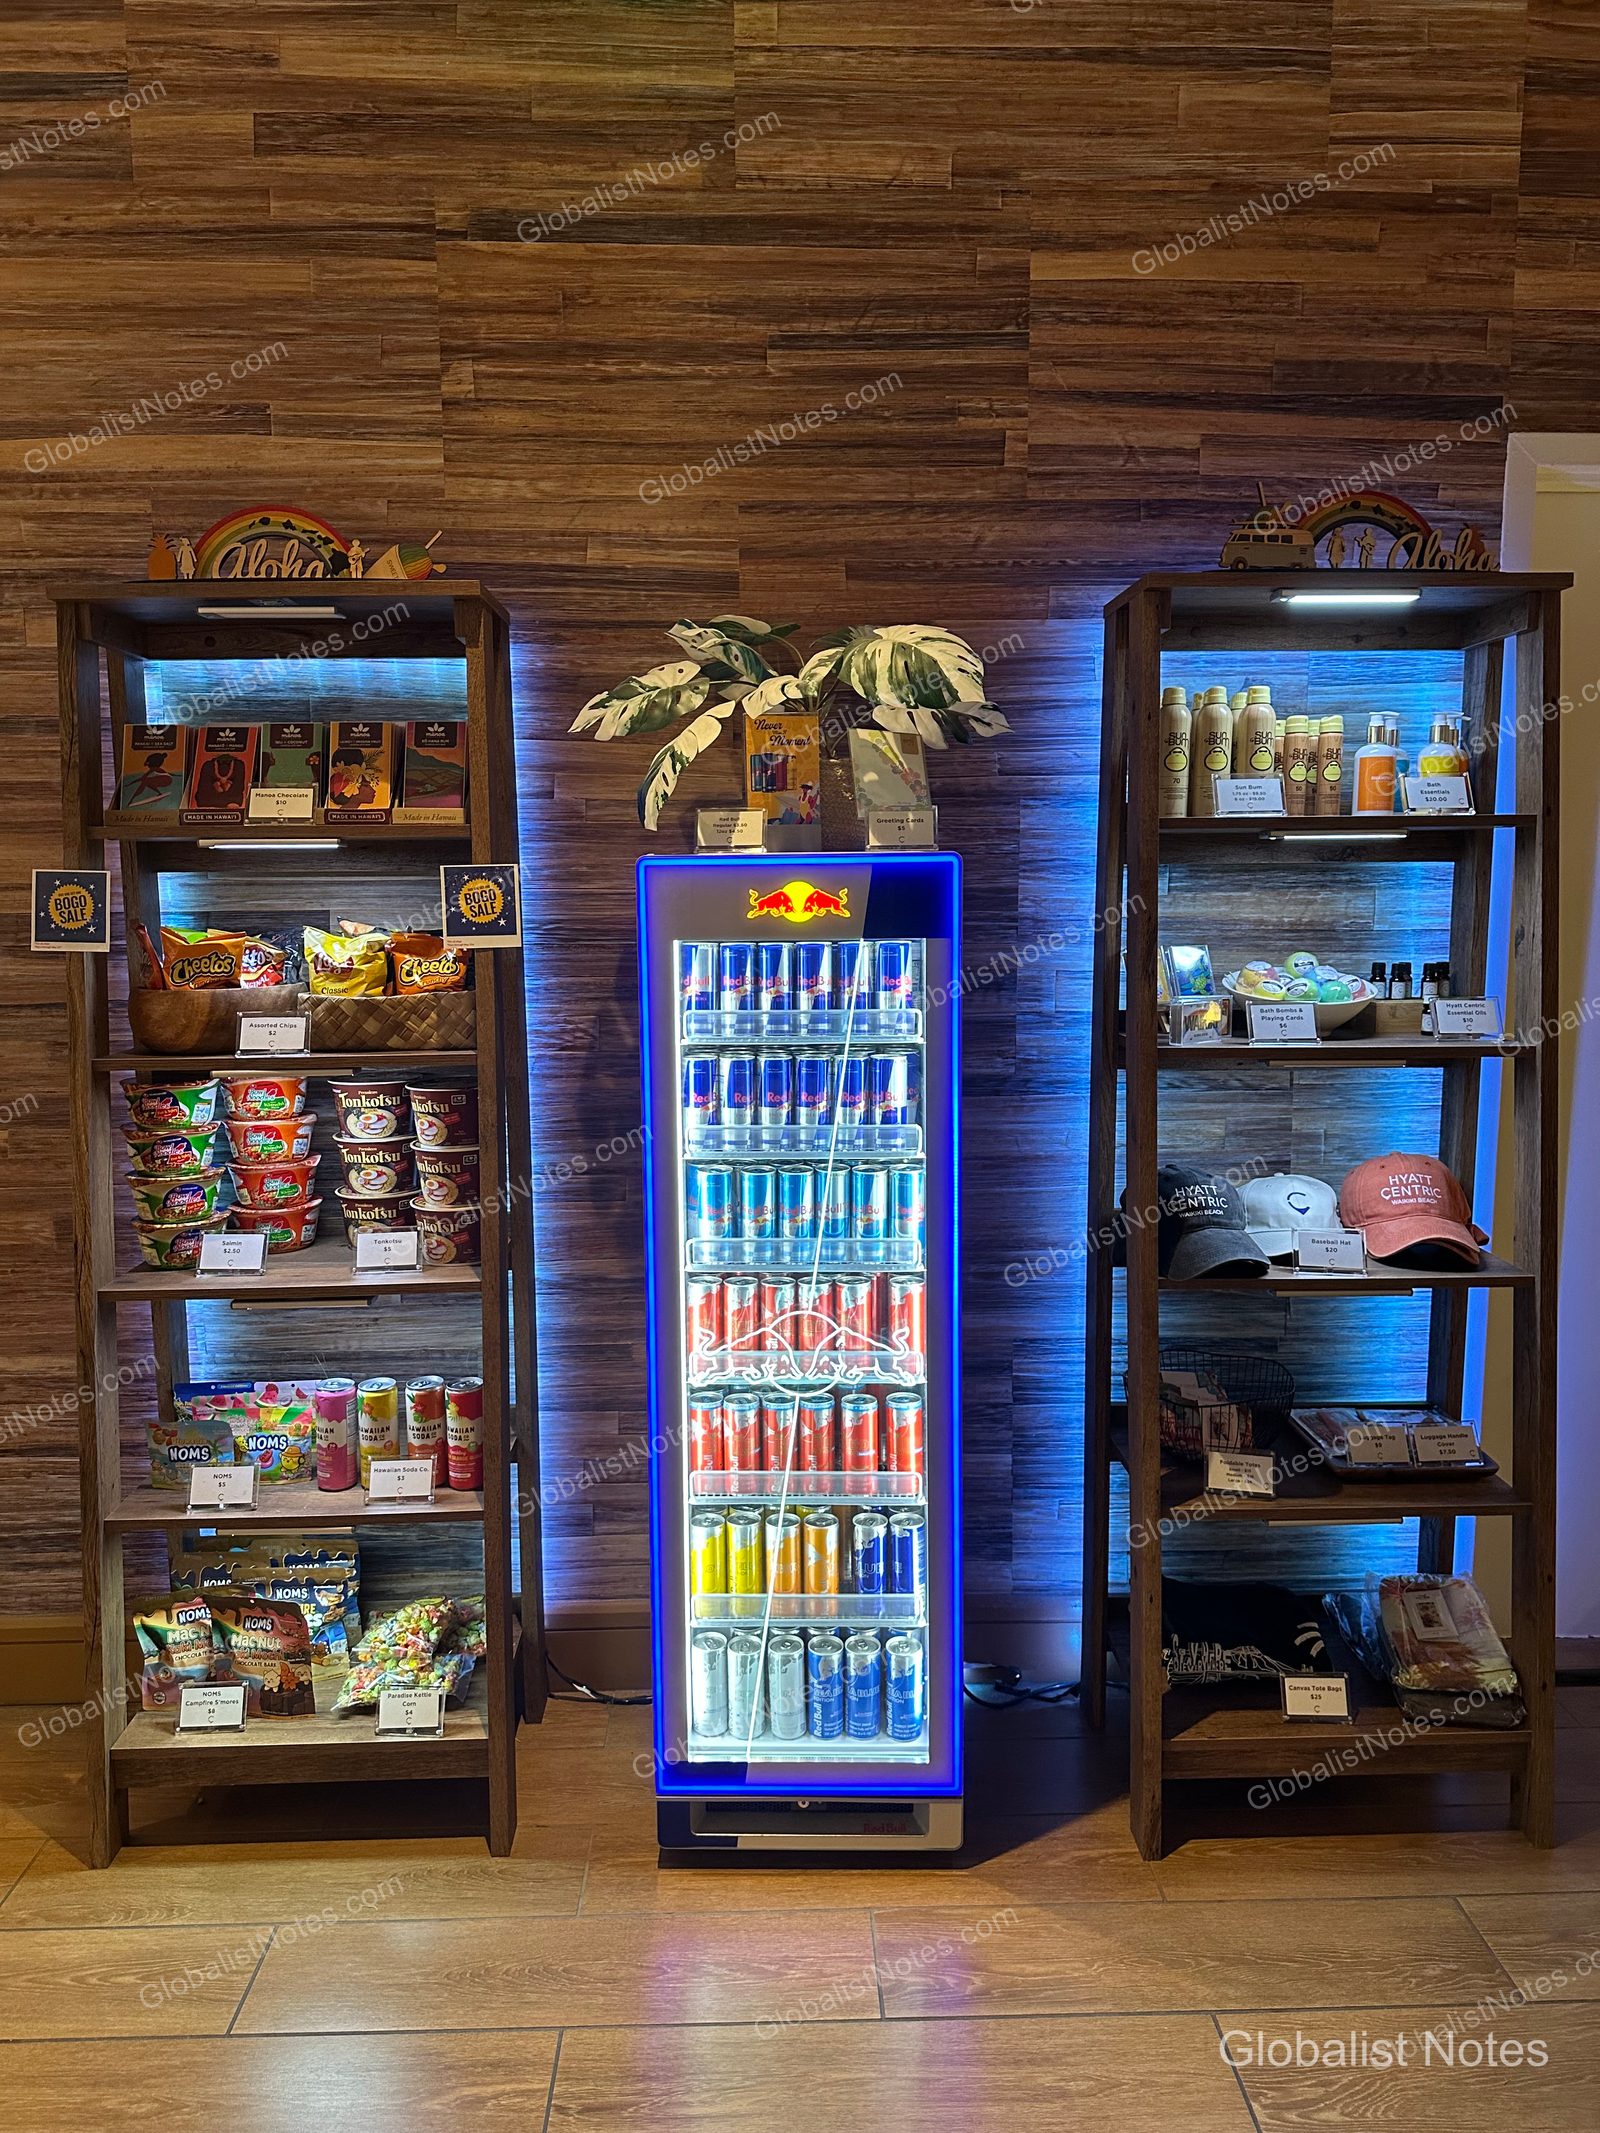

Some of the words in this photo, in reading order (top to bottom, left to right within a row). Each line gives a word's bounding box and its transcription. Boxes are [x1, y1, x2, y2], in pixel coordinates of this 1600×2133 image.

[1388, 528, 1501, 572] Aloha
[211, 538, 326, 579] Aloha
[753, 718, 784, 731] Never
[769, 734, 812, 747] Moment
[876, 817, 905, 825] Greeting
[54, 894, 88, 912] BOGO
[464, 888, 497, 906] BOGO
[59, 907, 88, 924] SALE
[469, 901, 498, 918] SALE
[170, 952, 235, 986] Cheetos
[722, 975, 743, 987] Red
[882, 975, 902, 987] Red
[321, 986, 350, 995] Classic
[1445, 1002, 1463, 1010] Hyatt
[1260, 1015, 1285, 1023] Playing
[248, 1022, 278, 1030] Assorted
[279, 1022, 298, 1030] Chips
[338, 1092, 401, 1109] Tonkotsu
[692, 1091, 712, 1103] Red
[734, 1091, 754, 1103] Red
[801, 1091, 822, 1103] Red
[842, 1091, 862, 1103] Red
[341, 1147, 401, 1165] Tonkotsu
[1388, 1172, 1433, 1186] HYATT
[1174, 1184, 1218, 1198] HYATT
[1380, 1184, 1442, 1200] CENTRIC
[1167, 1196, 1229, 1213] CENTRIC
[1391, 1197, 1417, 1206] WAIKIKI
[341, 1203, 397, 1220] Tonkotsu
[1204, 1208, 1225, 1217] BEACH
[373, 1238, 403, 1246] Tonkotsu
[1311, 1238, 1339, 1246] Baseball
[1325, 1246, 1338, 1254] $20
[361, 1433, 378, 1442] SODA
[412, 1431, 431, 1440] SODA
[1384, 1434, 1396, 1442] Tag
[1420, 1433, 1447, 1441] Luggage
[247, 1434, 289, 1451] NOMS
[169, 1446, 211, 1463] NOMS
[373, 1466, 402, 1474] Hawaiian
[1244, 1461, 1261, 1469] Totes
[275, 1586, 309, 1600] NOMS
[178, 1607, 212, 1625] NOMS
[243, 1616, 275, 1632] NOMS
[167, 1627, 198, 1644] Mac
[174, 1650, 208, 1662] CHOCOLATE
[1327, 1685, 1343, 1693] Bags
[185, 1699, 214, 1708] Campfire
[214, 1698, 240, 1706] S'mores
[1310, 1693, 1323, 1701] $25
[813, 1702, 823, 1720] Bull
[813, 1719, 823, 1737] Red
